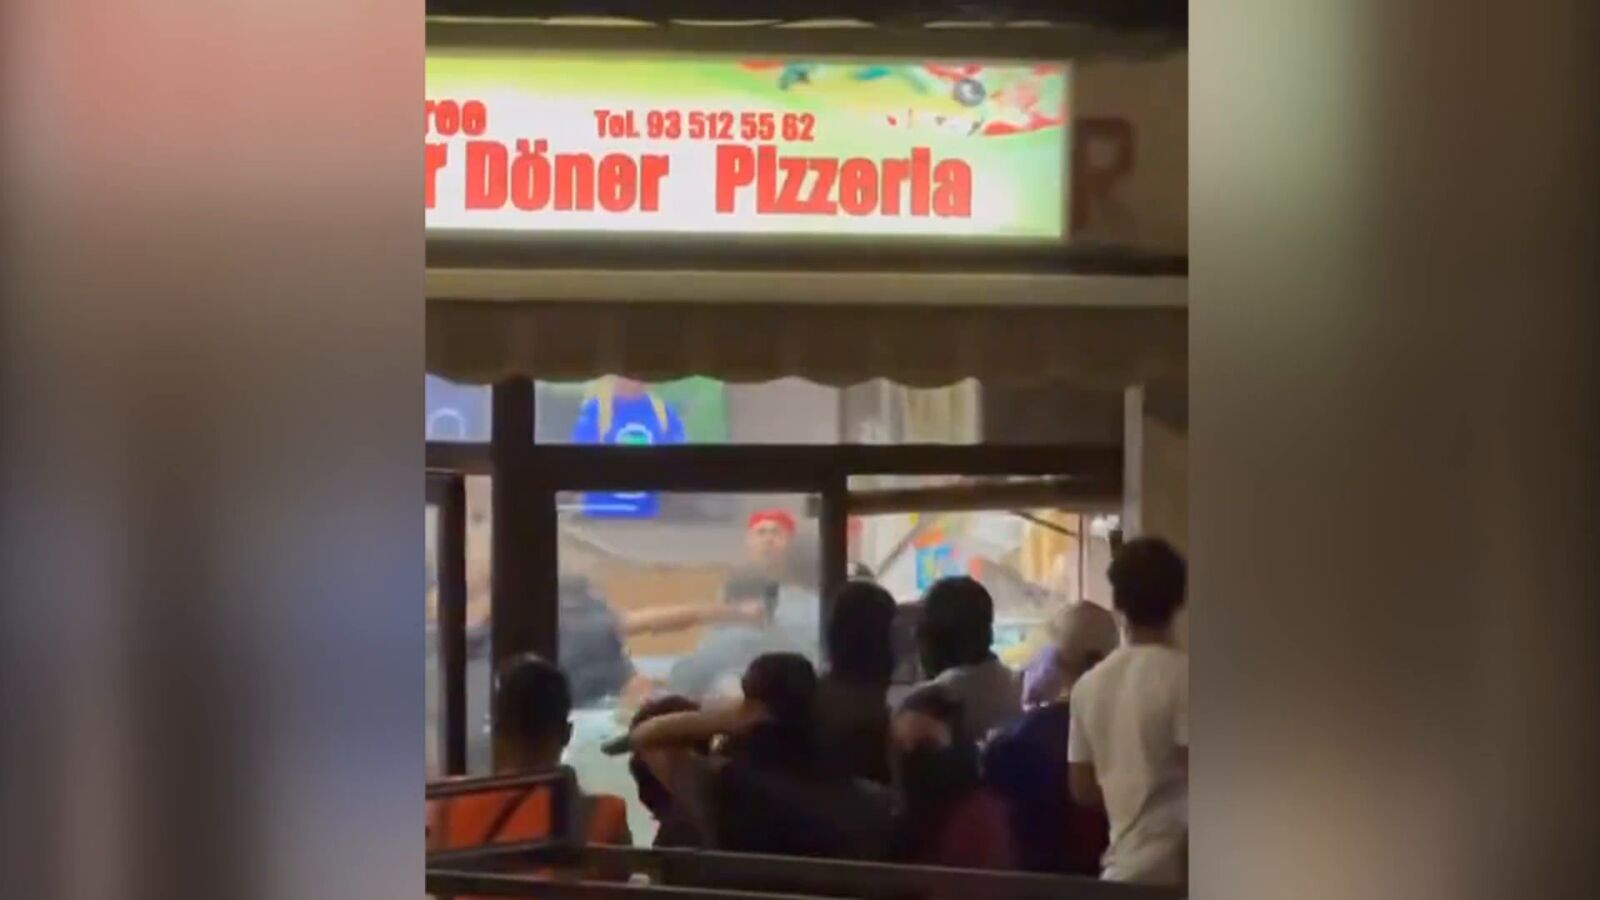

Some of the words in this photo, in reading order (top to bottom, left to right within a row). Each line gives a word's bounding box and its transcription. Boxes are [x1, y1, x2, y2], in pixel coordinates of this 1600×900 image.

[594, 109, 638, 139] Tel.
[647, 109, 683, 140] 93
[688, 111, 735, 141] 512
[740, 112, 777, 142] 55
[465, 138, 670, 213] Döner
[715, 142, 973, 218] Pizzeria
